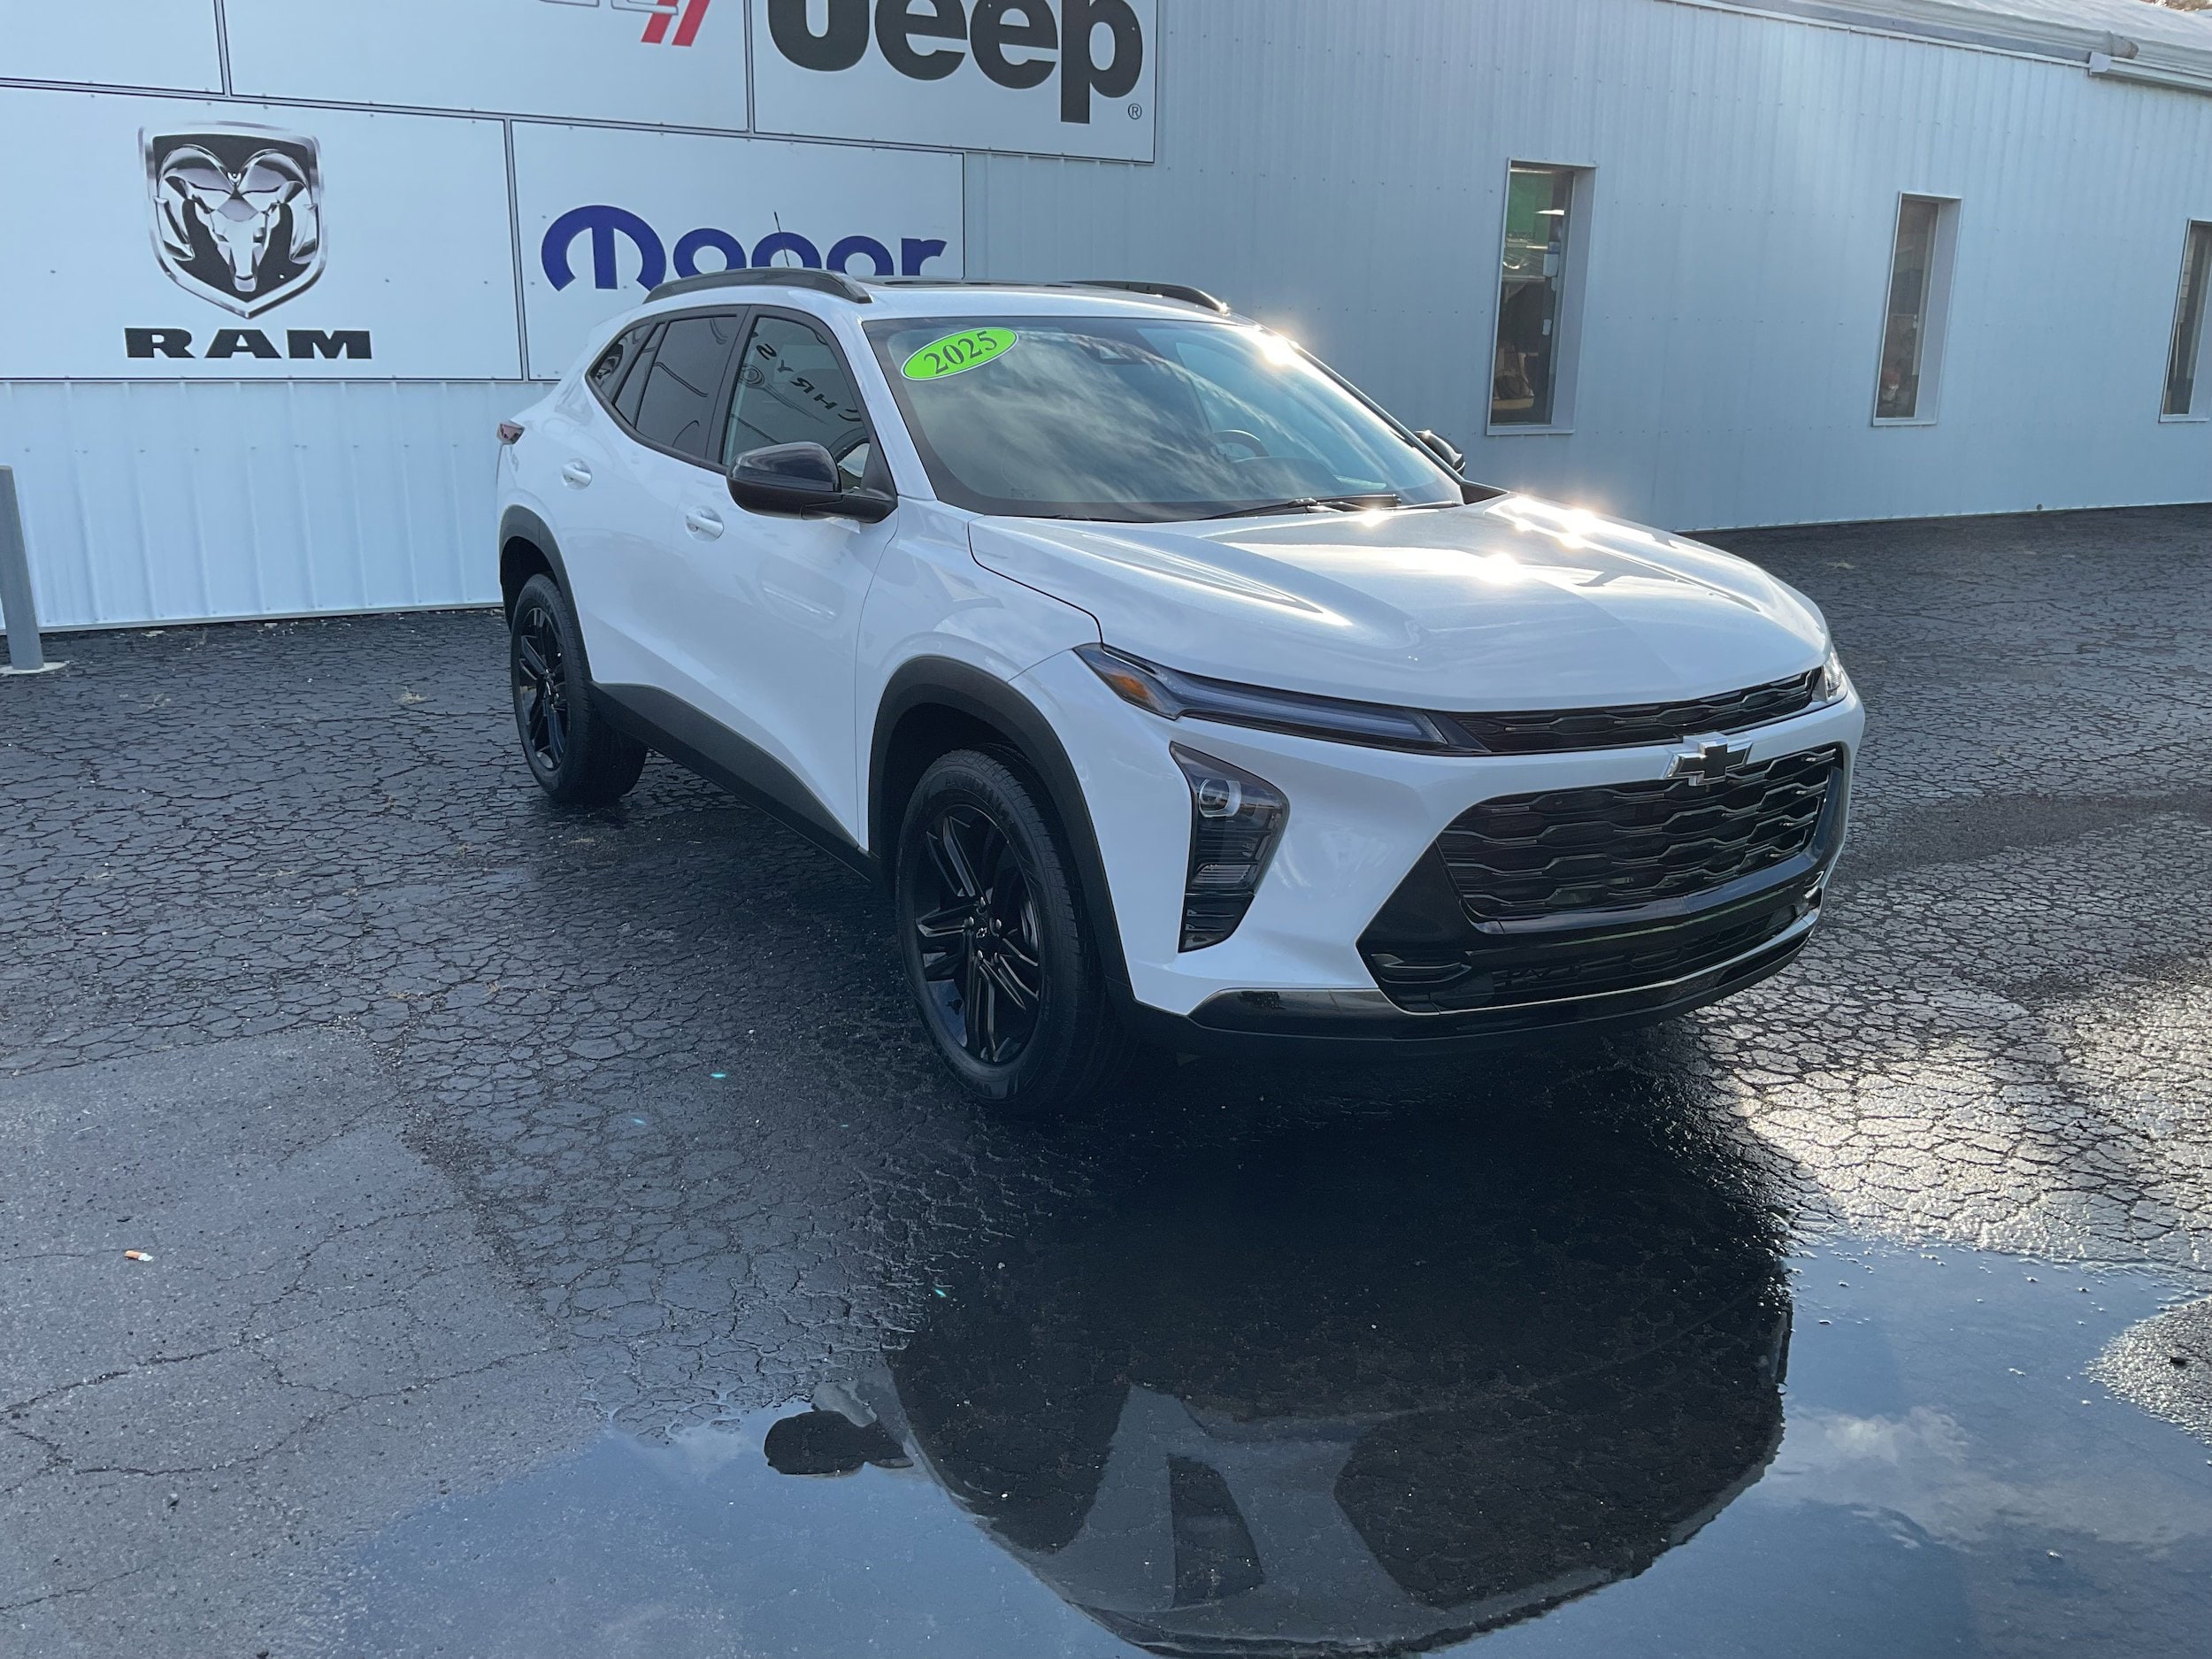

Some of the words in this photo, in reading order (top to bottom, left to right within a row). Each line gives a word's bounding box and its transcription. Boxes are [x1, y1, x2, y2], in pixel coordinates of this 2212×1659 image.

[767, 0, 1143, 124] Jeep
[125, 327, 372, 359] RAM
[923, 330, 998, 374] 2025
